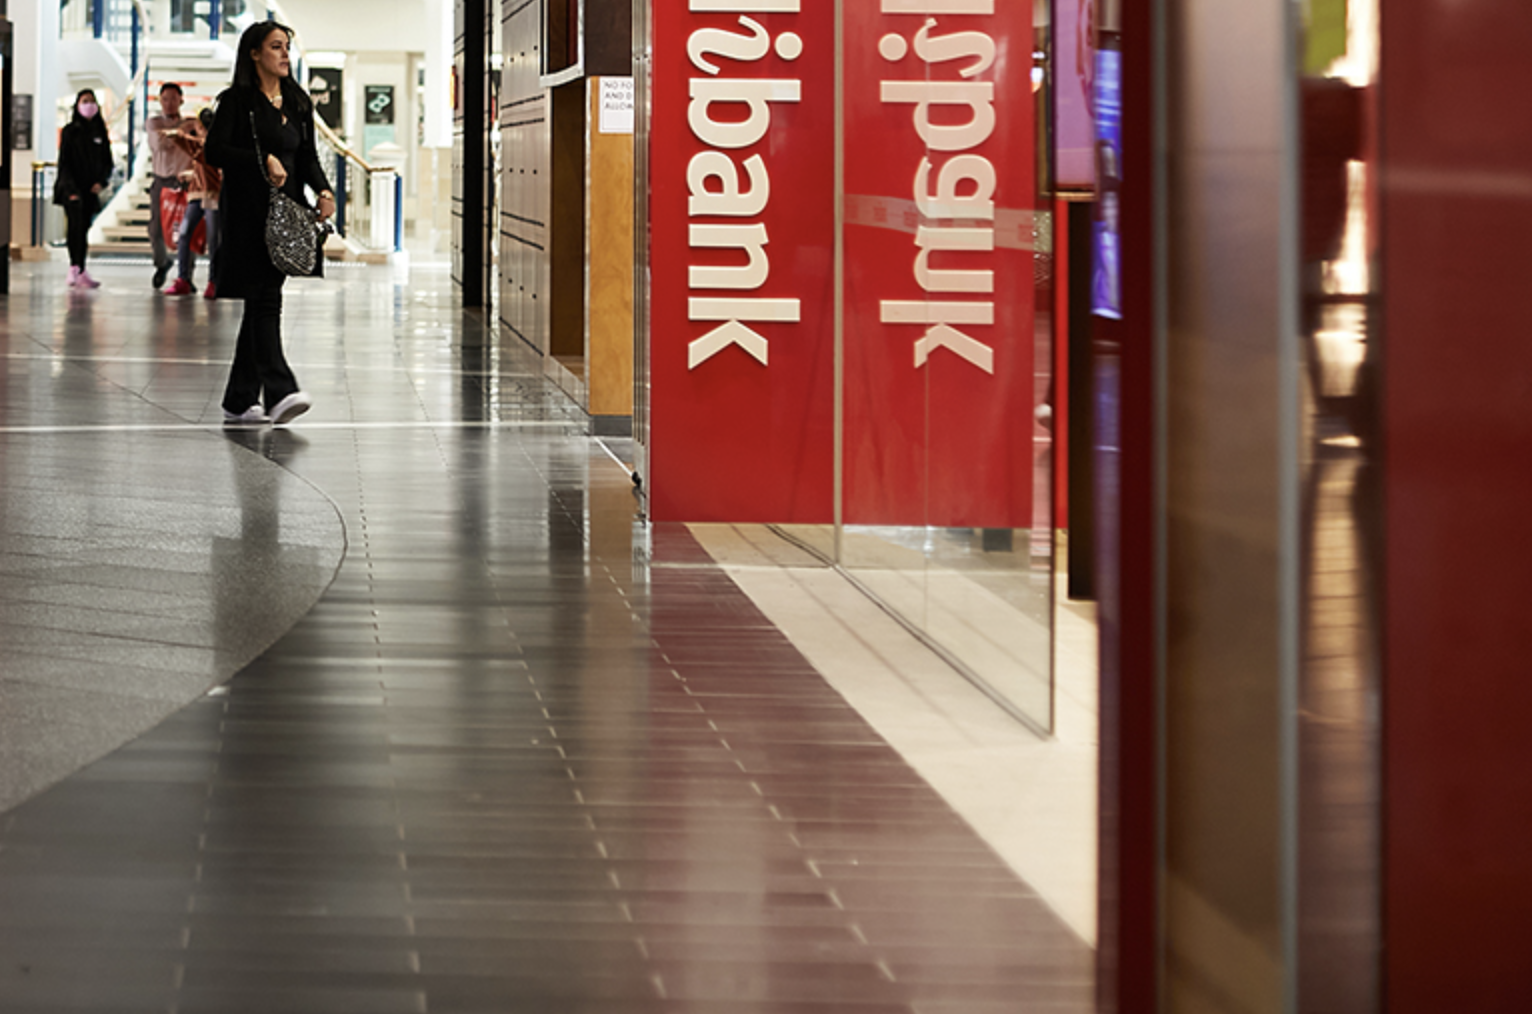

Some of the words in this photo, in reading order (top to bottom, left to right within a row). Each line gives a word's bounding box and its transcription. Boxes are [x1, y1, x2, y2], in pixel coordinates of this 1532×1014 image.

[604, 81, 618, 90] NO
[621, 81, 633, 90] FO
[604, 92, 624, 101] AND
